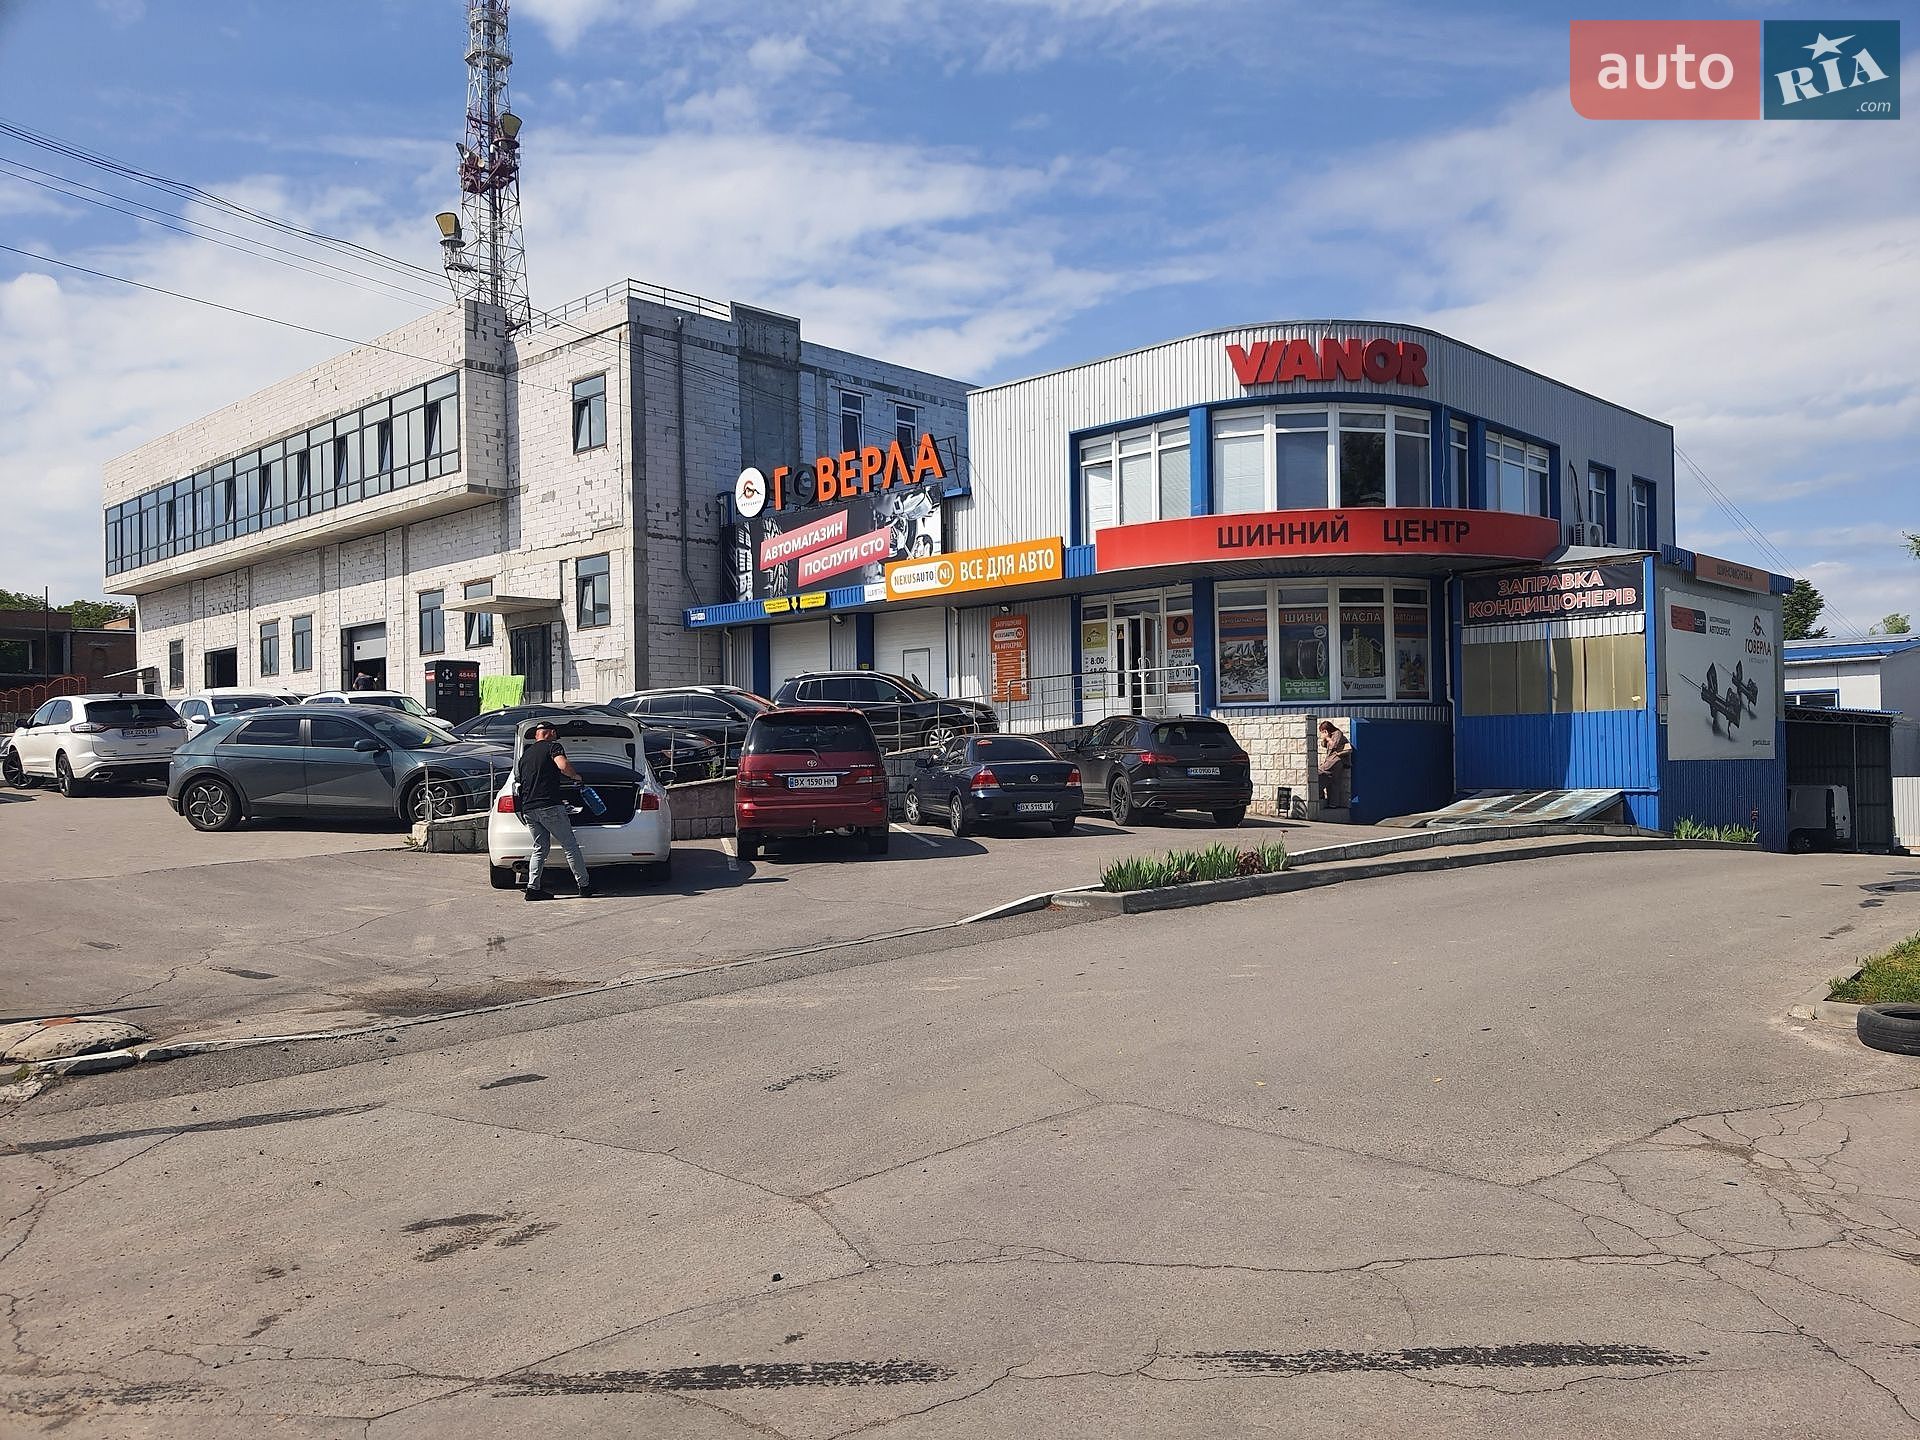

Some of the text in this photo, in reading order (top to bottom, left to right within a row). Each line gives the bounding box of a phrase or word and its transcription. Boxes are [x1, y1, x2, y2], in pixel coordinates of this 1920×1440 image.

[1225, 338, 1429, 387] VIANOR
[764, 521, 844, 562] АВТОМАГАЗИН
[1218, 514, 1471, 549] ШИННИЙ ЦЕНТР
[804, 537, 885, 577] ПОСЛУГИ СТО
[960, 548, 1054, 581] ВСЕ ДЛЯ АВТО
[894, 571, 934, 586] NEXUSAUTO
[1498, 570, 1604, 597] ЗАПРАВКА
[1285, 612, 1322, 623] ШИНИ
[1342, 612, 1381, 622] МАСЛА
[1468, 588, 1637, 619] КОНДИЦІОНЕРІВ
[1745, 638, 1772, 657] ГОВЕРЛА
[794, 777, 804, 786] BX
[807, 777, 822, 786] 1590
